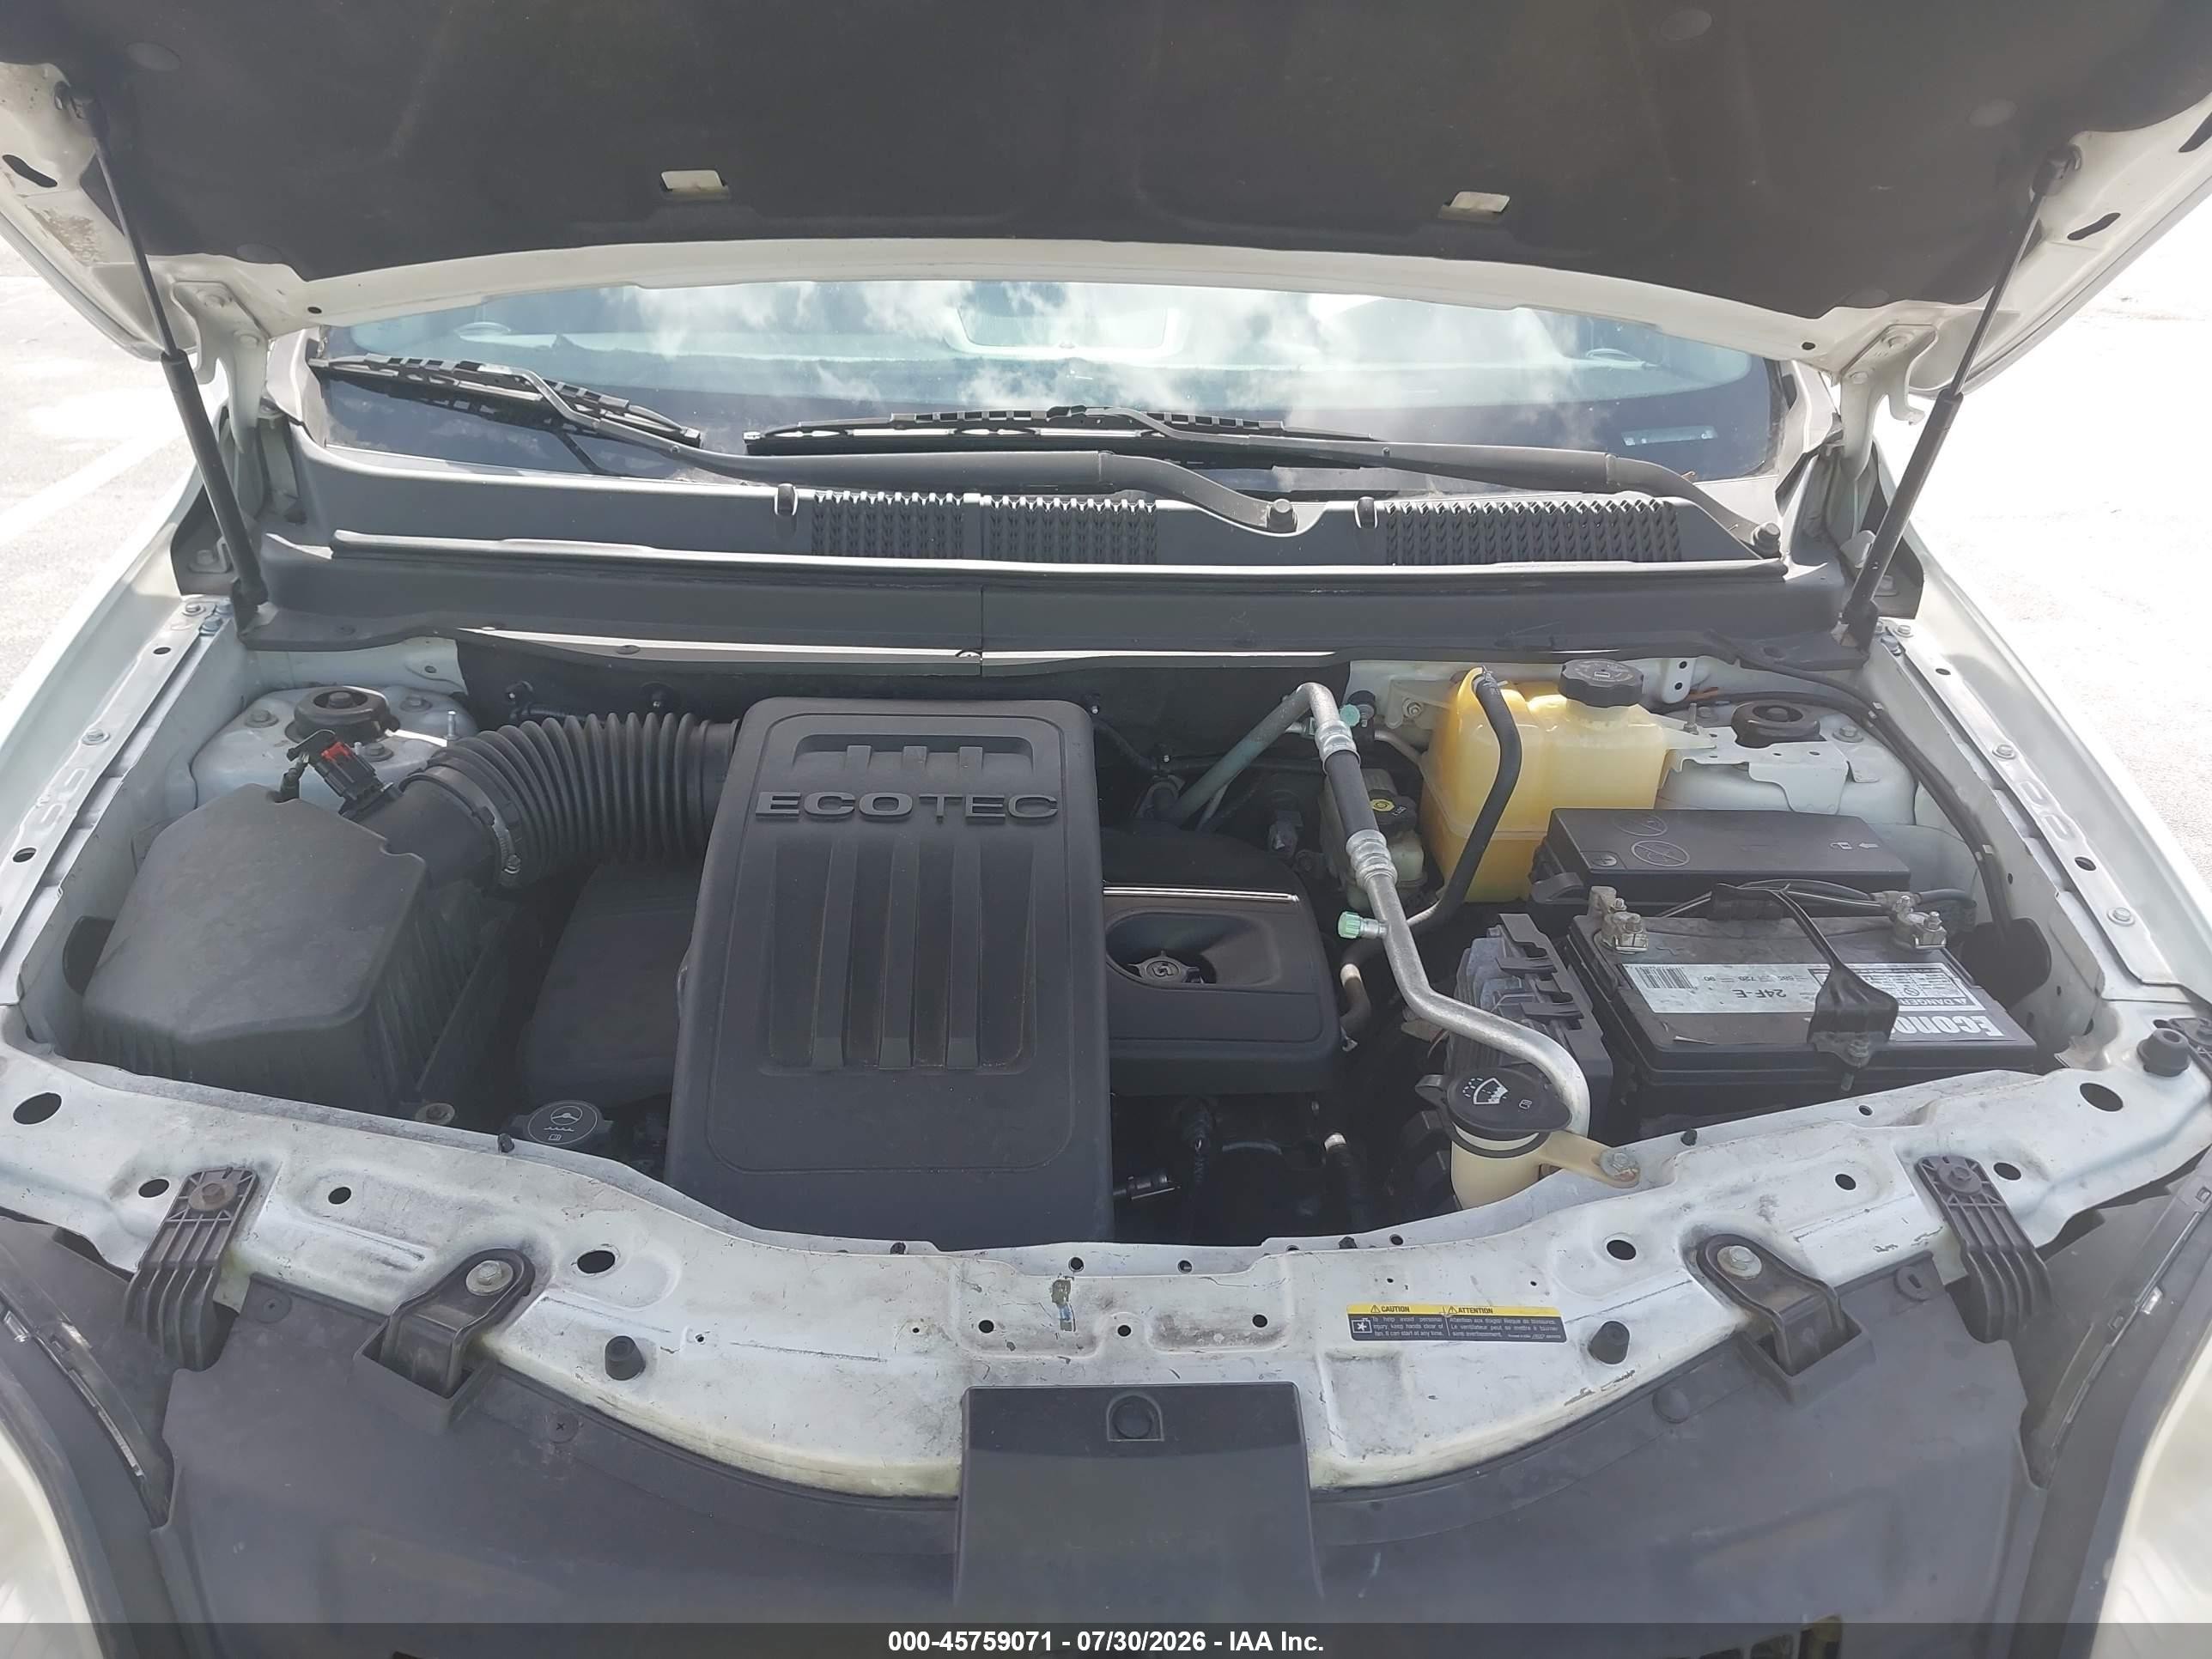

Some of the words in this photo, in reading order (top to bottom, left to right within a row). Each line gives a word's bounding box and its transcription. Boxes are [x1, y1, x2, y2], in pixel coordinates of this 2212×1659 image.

[756, 792, 1059, 822] ECOTEC
[1731, 988, 1787, 999] 24F-E
[1891, 1016, 2006, 1036] Econo
